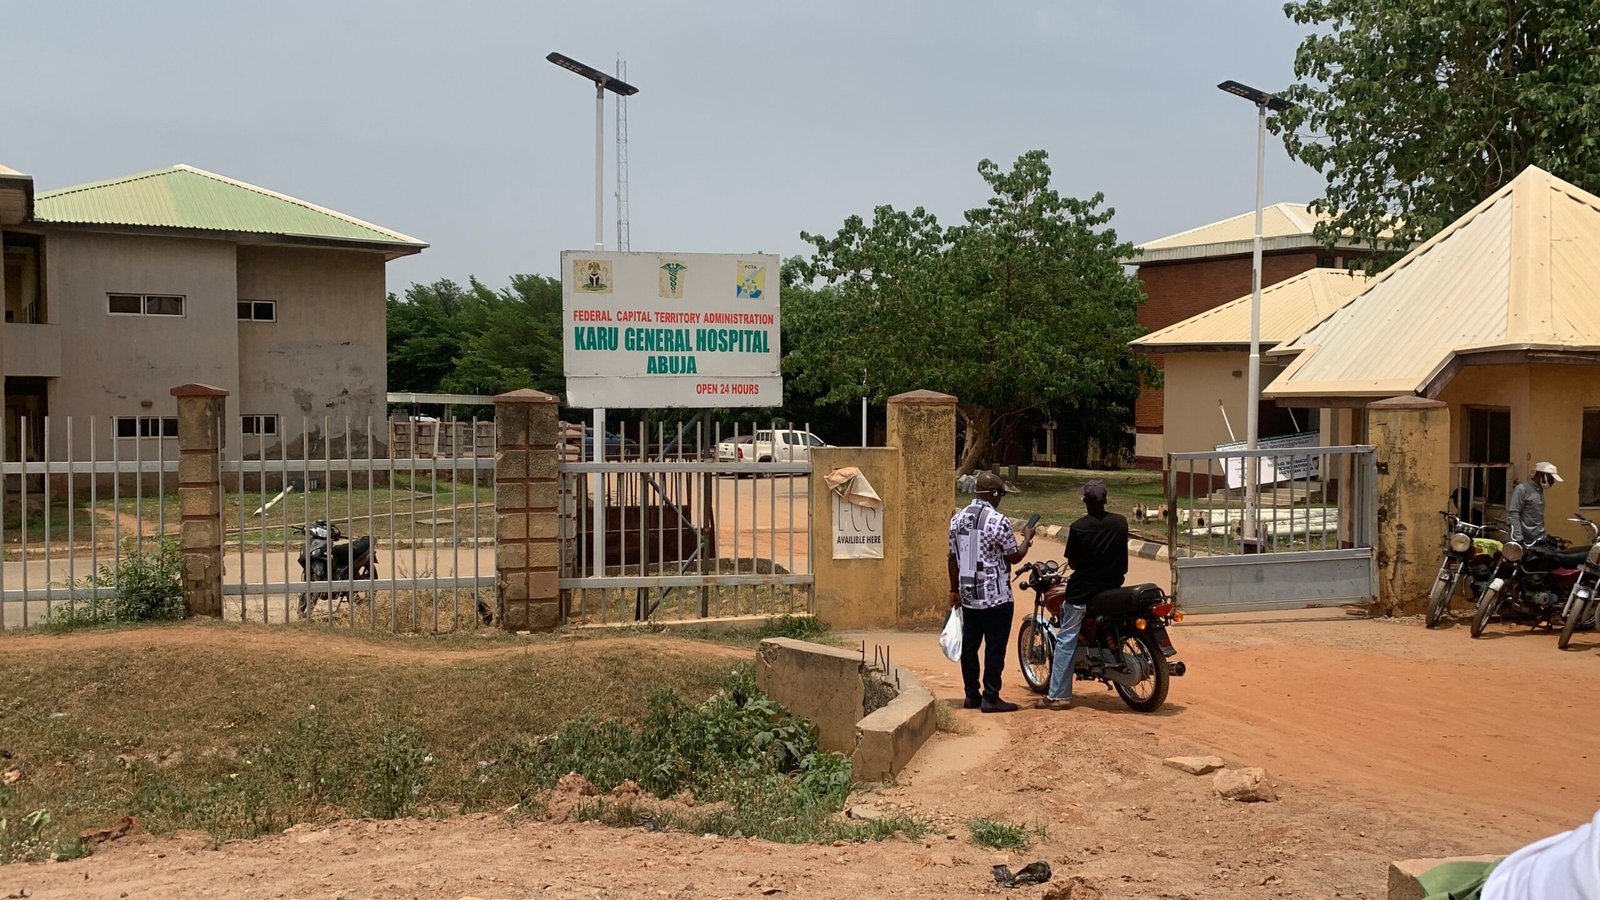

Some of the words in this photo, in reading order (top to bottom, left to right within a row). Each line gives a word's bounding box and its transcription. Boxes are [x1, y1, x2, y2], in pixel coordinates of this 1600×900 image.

[573, 310, 612, 322] FEDERAL
[616, 310, 652, 323] CAPITAL
[654, 311, 701, 324] TERRITORY
[703, 312, 774, 325] ADMINISTRATION
[574, 326, 619, 351] KARU
[624, 327, 693, 352] GENERAL
[696, 328, 770, 353] HOSPITAL
[646, 355, 697, 375] ABUJA
[696, 383, 718, 395] OPEN
[719, 383, 730, 395] 24
[731, 383, 760, 395] HOURS
[866, 535, 881, 545] HERE
